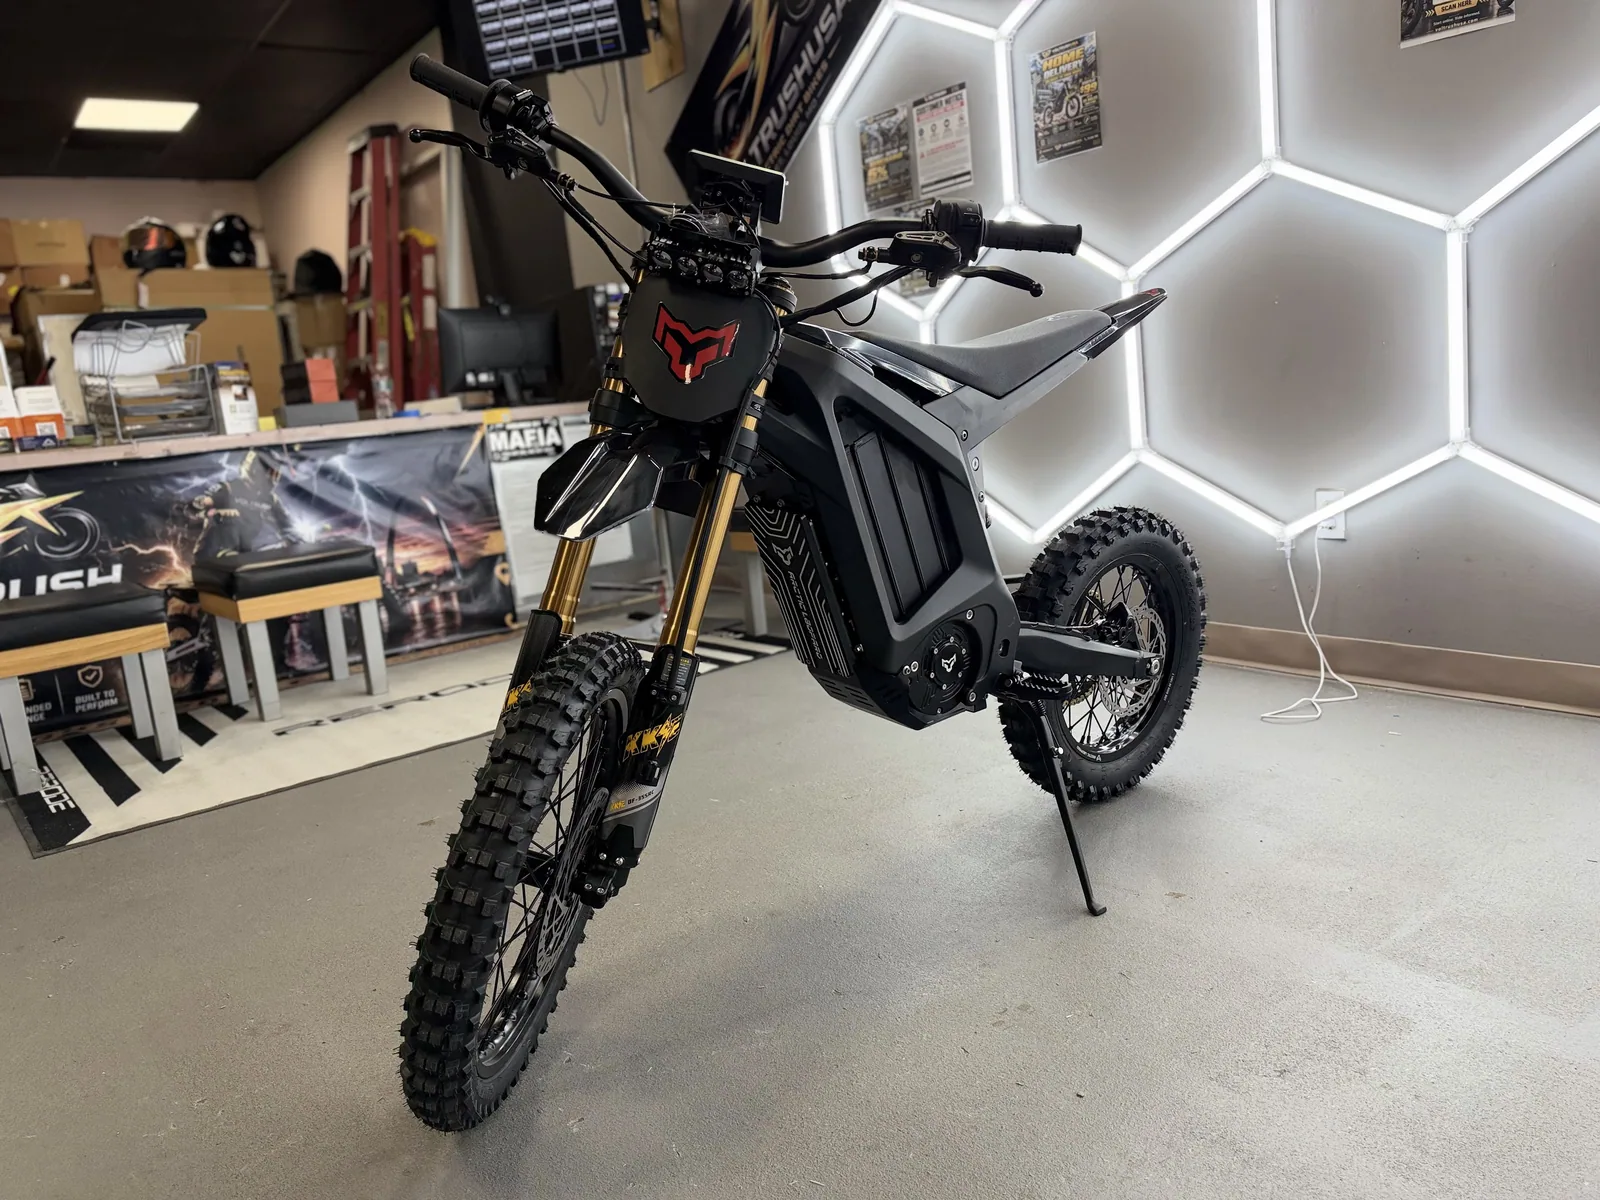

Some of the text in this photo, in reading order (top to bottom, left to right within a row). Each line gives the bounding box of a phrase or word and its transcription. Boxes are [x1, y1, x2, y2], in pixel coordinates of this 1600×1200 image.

[1441, 0, 1472, 12] SCAN HERE
[1042, 47, 1084, 71] HOME
[1043, 59, 1083, 79] DELIVERY
[489, 425, 562, 452] MAFIA
[75, 689, 115, 704] BUILT TO
[25, 702, 53, 714] NDED
[75, 697, 118, 713] PERFORM
